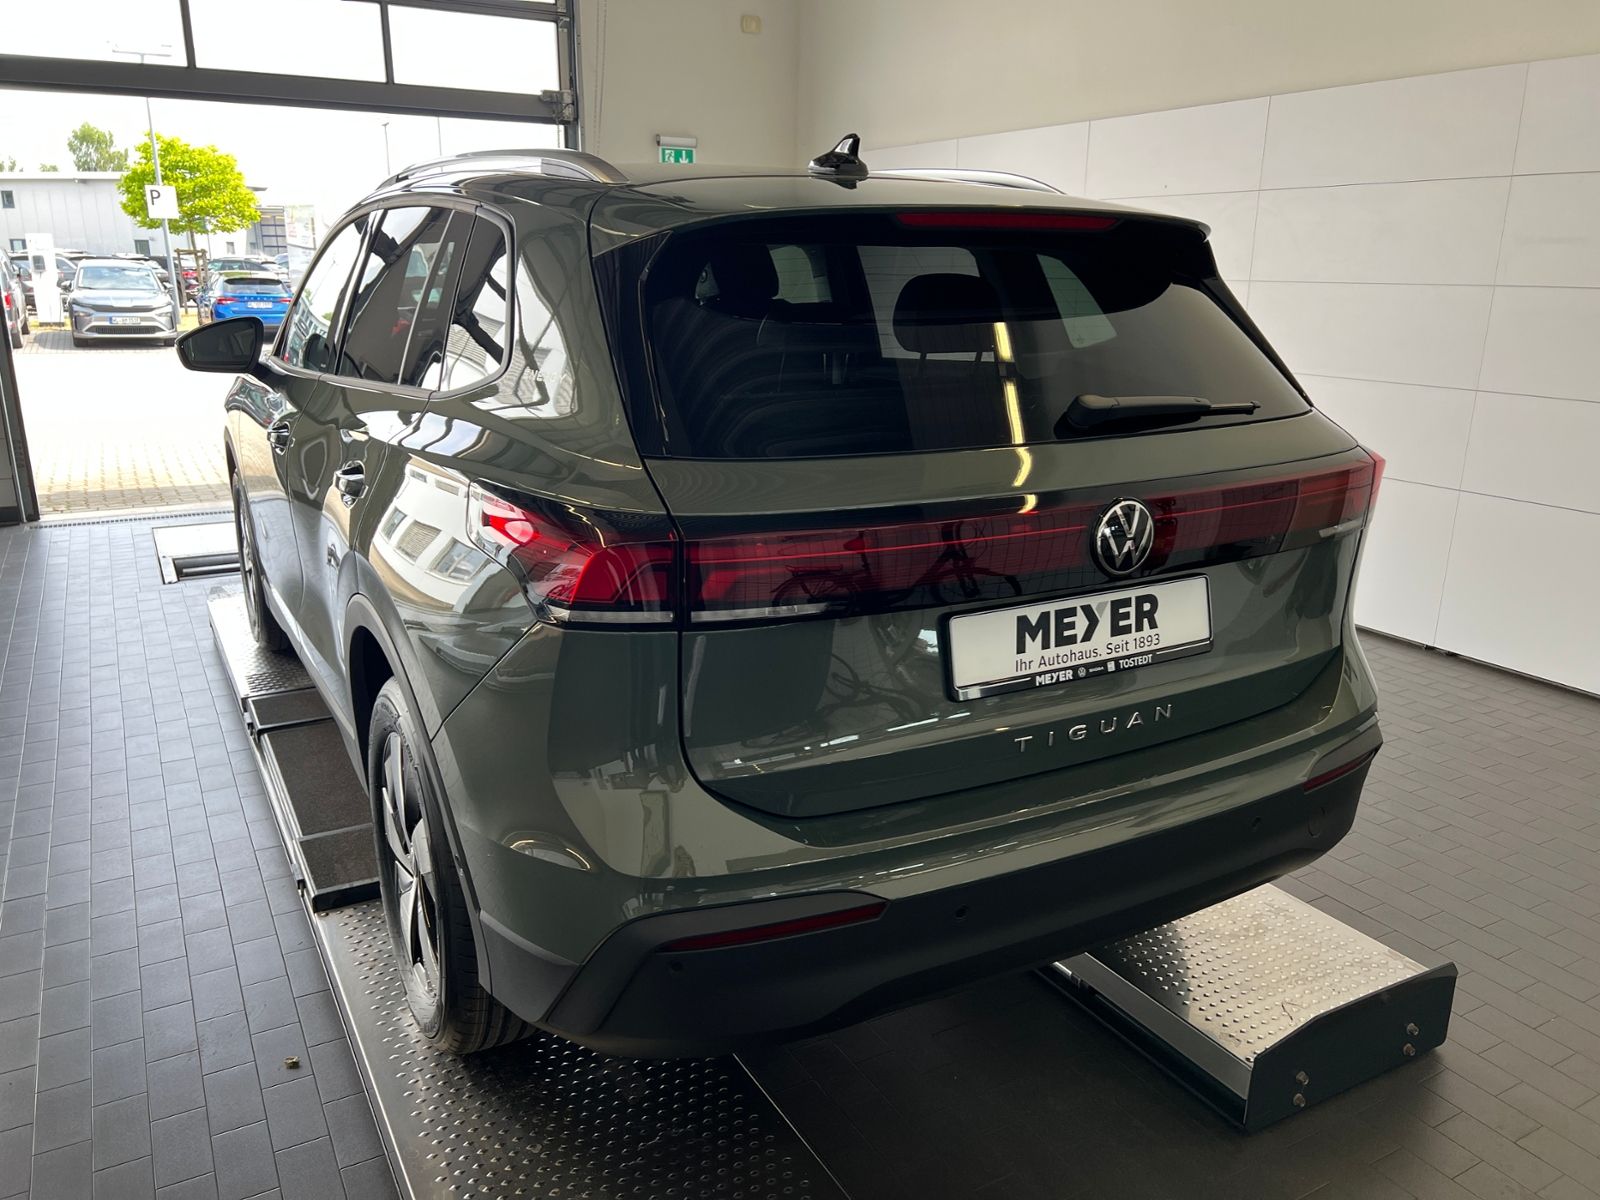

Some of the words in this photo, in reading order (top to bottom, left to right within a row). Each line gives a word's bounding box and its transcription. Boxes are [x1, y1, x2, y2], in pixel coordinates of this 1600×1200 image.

[150, 189, 161, 206] P
[1016, 593, 1159, 655] MEYER
[1015, 658, 1034, 672] Ihr
[1038, 647, 1102, 669] Autohaus.
[1106, 640, 1130, 655] Seit
[1133, 633, 1160, 649] 1893
[1035, 669, 1073, 686] MEYER
[1118, 654, 1153, 669] TOSTEDT
[1014, 704, 1172, 752] TIGUAN
